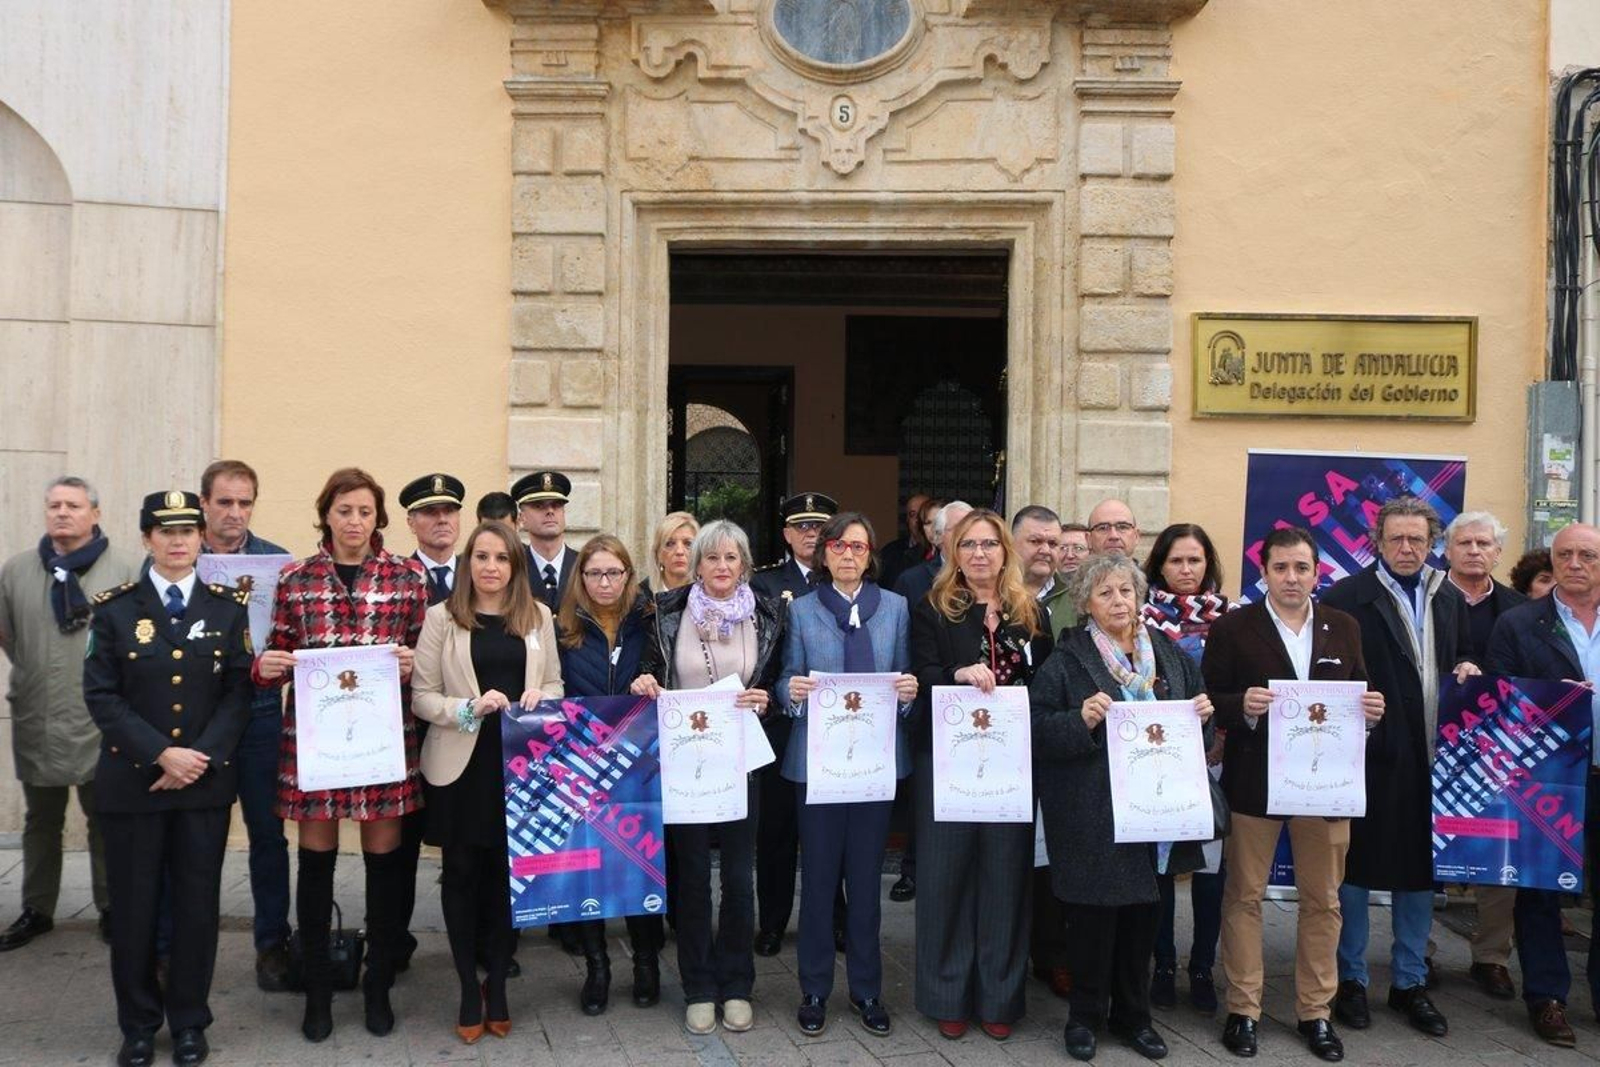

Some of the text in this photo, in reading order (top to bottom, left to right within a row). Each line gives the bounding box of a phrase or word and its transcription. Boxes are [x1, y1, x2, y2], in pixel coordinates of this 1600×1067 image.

[839, 105, 850, 123] 5
[1252, 351, 1459, 377] JUNTA DE ANDALUCIA
[1250, 381, 1459, 404] Delegación del Gobierno
[1440, 676, 1516, 746] PASA
[1497, 700, 1545, 737] LA
[508, 700, 587, 782] PASA
[568, 720, 615, 759] LA
[1475, 734, 1585, 841] ACCIÓN
[548, 762, 663, 861] ACCIÓN
